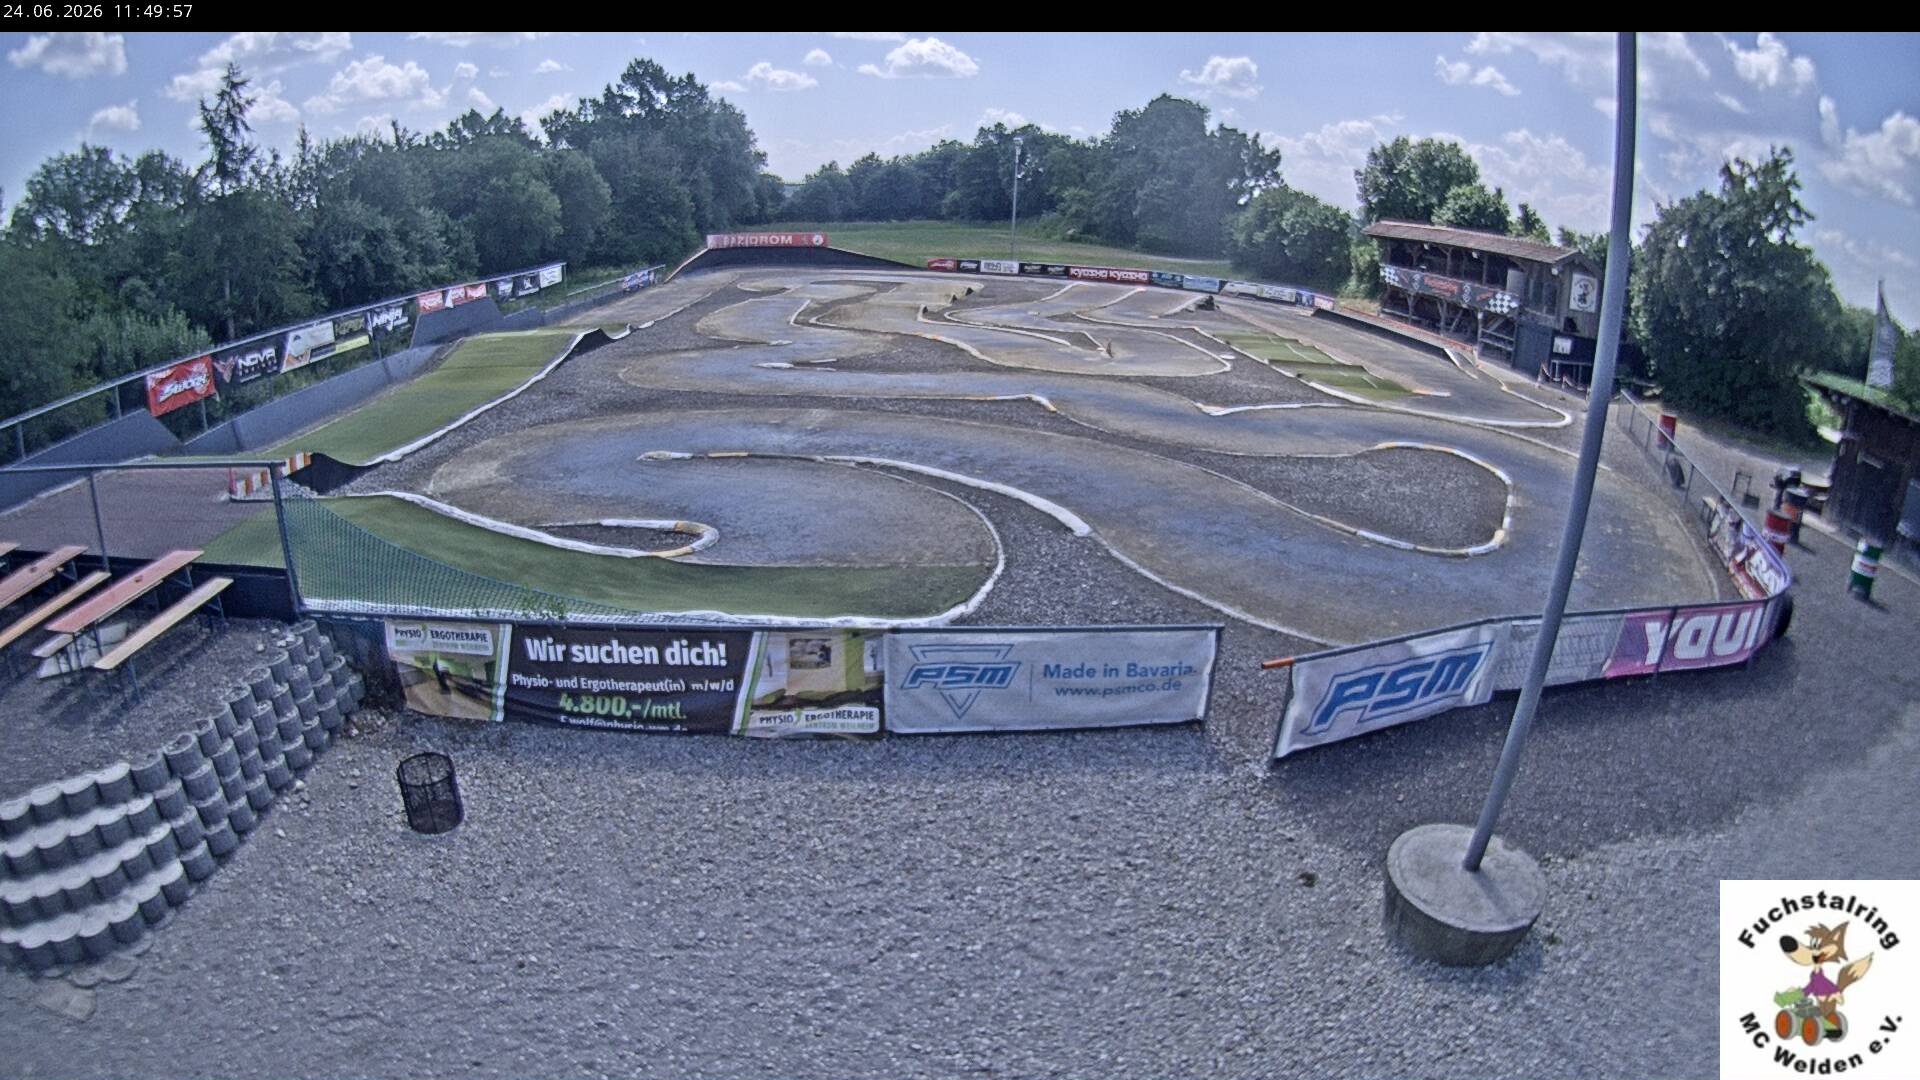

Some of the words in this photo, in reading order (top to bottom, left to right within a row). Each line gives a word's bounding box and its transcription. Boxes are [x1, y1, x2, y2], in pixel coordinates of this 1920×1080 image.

[1070, 268, 1108, 278] KYOSHO
[1109, 270, 1148, 281] KYOSHO
[237, 348, 276, 368] NOVA
[394, 628, 422, 638] PHYSIO
[430, 630, 489, 642] ERGOTHERAPIE
[525, 638, 566, 663] Wir
[571, 640, 660, 665] suchen
[665, 640, 728, 667] dich!
[909, 666, 1012, 685] PSM
[1043, 663, 1097, 679] Made
[1103, 662, 1119, 678] in
[512, 673, 554, 689] Physio-
[556, 678, 578, 689] und
[580, 677, 686, 693] Ergotherapeut(in)
[691, 680, 735, 692] m/w/d
[1055, 680, 1182, 697] www.psmco.de
[1314, 651, 1482, 728] PSM
[760, 715, 794, 724] PHYSIO
